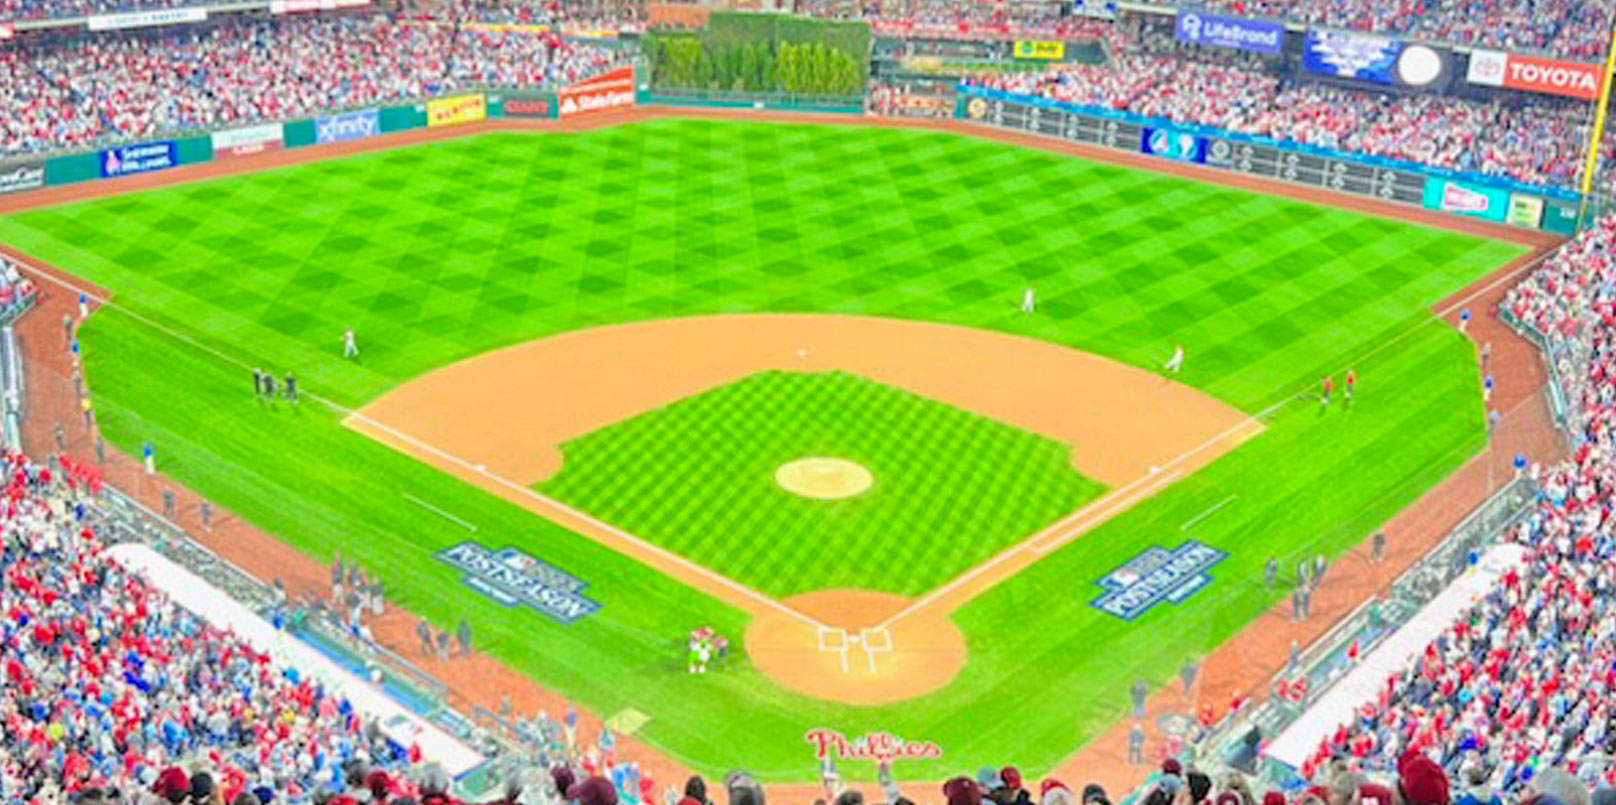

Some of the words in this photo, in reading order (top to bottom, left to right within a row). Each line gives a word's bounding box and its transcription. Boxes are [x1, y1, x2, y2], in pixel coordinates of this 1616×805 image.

[1204, 22, 1277, 45] LifeBrand
[1510, 62, 1597, 91] TOYOTA
[317, 112, 378, 141] xfinity
[447, 543, 584, 617] POSTSEASON
[1102, 545, 1217, 616] POSTSEASON
[806, 728, 944, 762] Phillies
